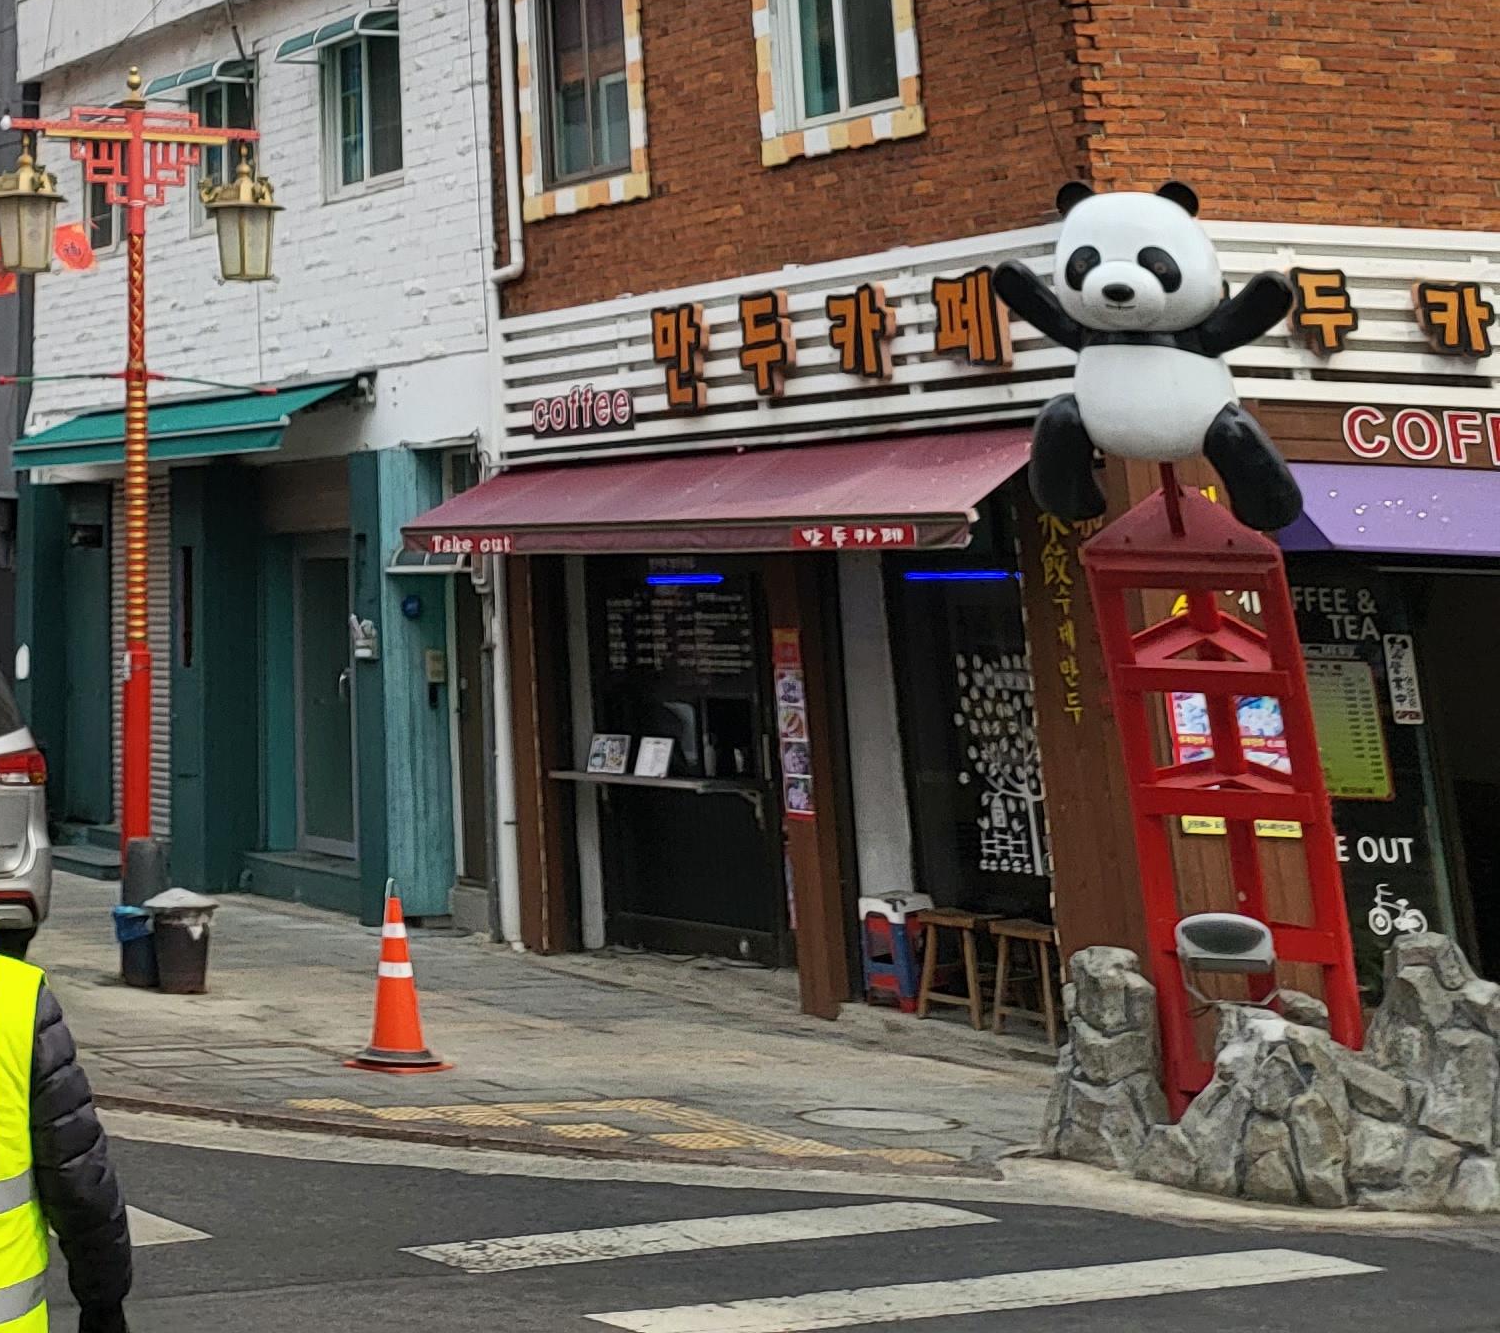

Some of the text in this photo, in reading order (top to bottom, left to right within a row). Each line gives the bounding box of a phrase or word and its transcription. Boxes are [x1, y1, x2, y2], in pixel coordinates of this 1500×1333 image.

[1285, 266, 1496, 358] 두카
[650, 264, 1014, 411] 만두카페
[531, 384, 634, 434] coffee
[431, 534, 512, 554] Take out
[800, 525, 905, 549] 만두카페
[1291, 585, 1350, 613] FFEE
[1326, 614, 1382, 642] TEA
[1356, 835, 1414, 864] OUT
